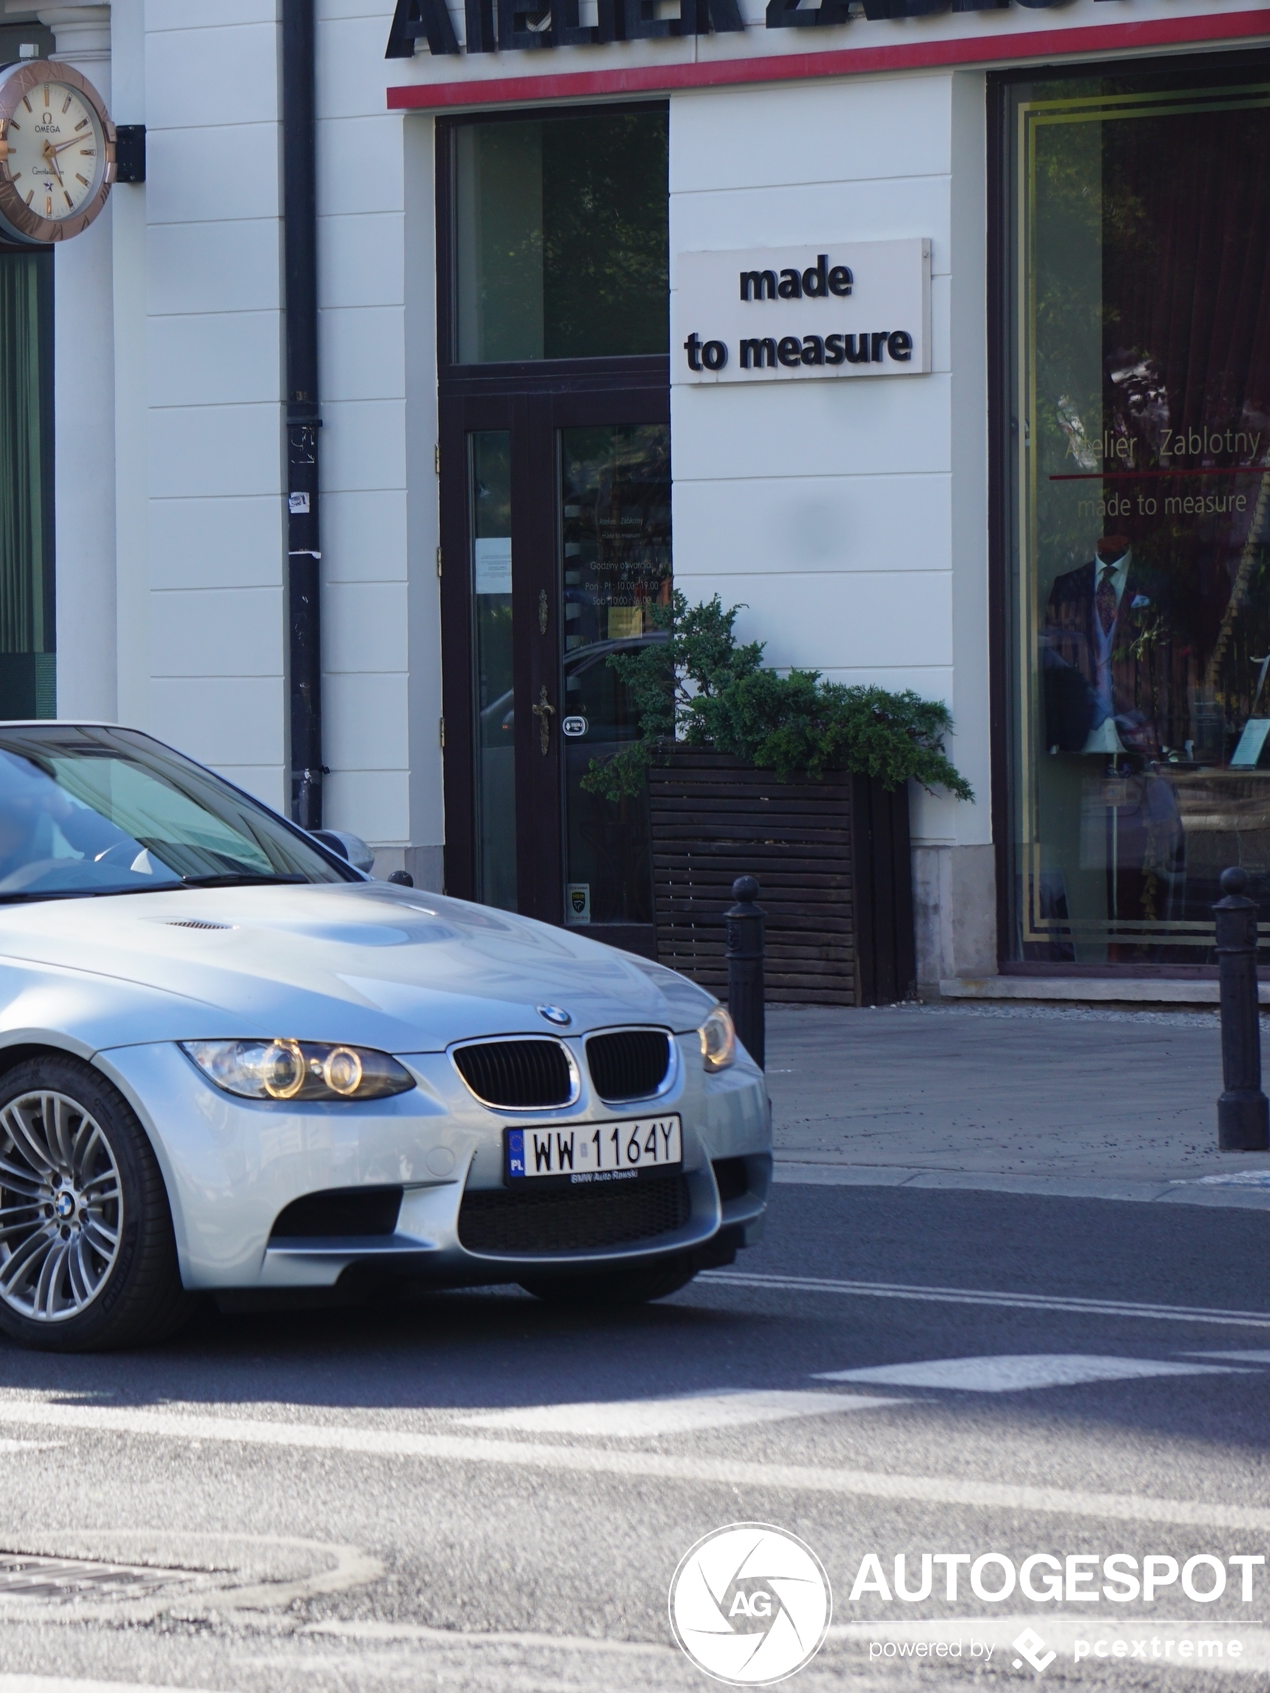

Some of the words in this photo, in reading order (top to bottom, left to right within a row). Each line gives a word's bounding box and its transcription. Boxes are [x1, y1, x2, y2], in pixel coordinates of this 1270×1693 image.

[34, 125, 61, 134] OMEGA
[740, 254, 853, 301] made
[684, 332, 728, 371] to
[740, 330, 912, 368] measure
[1065, 430, 1137, 459] Atelier
[1160, 426, 1261, 460] Zablotny
[1079, 492, 1130, 517] made
[1138, 494, 1157, 516] to
[1165, 494, 1247, 515] measure
[590, 562, 619, 571] Godziny
[585, 582, 598, 590] Pon
[618, 581, 634, 590] 10.00
[641, 581, 658, 590] 19.00
[592, 596, 606, 606] Sob
[533, 1132, 574, 1172] WW
[592, 1121, 673, 1167] 1164Y
[511, 1160, 524, 1171] PL
[571, 1173, 592, 1183] BMW
[593, 1172, 611, 1182] Auto
